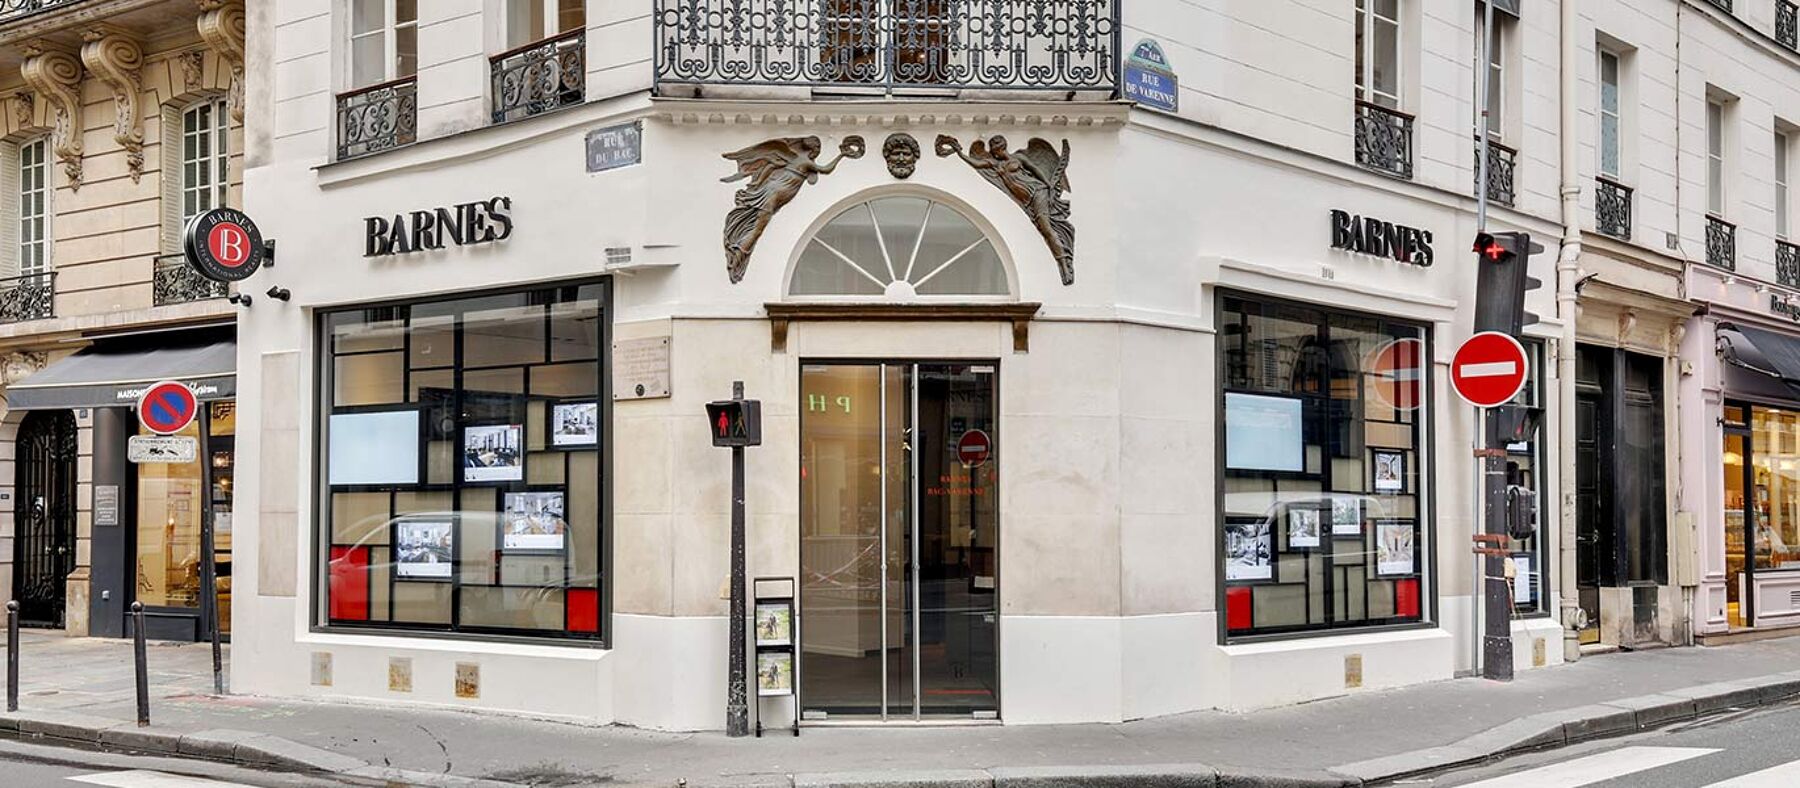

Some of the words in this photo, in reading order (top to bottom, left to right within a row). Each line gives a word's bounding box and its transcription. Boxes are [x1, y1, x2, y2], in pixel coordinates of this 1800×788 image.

[1142, 73, 1159, 87] RUE
[1126, 82, 1137, 95] DE
[1139, 86, 1176, 105] VARENNE
[604, 132, 625, 148] RUE
[596, 152, 608, 164] DU
[208, 211, 252, 234] BARNES
[363, 196, 513, 257] BARNES
[220, 228, 243, 261] B
[1330, 209, 1433, 268] BARNES
